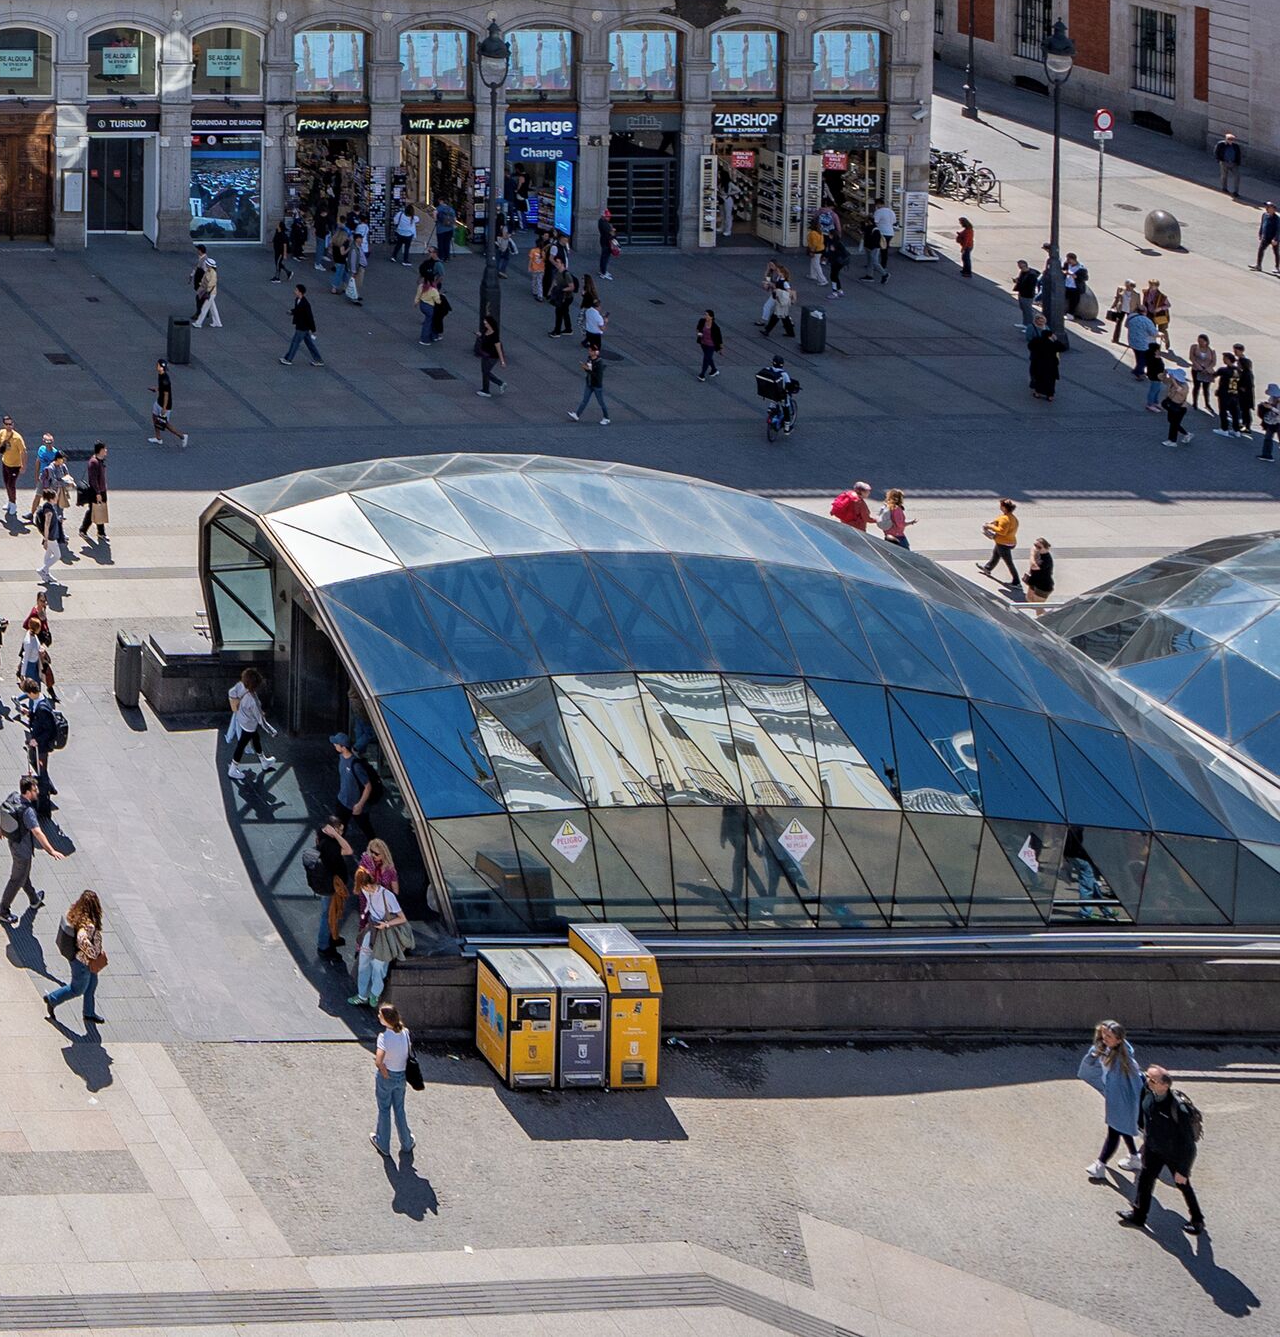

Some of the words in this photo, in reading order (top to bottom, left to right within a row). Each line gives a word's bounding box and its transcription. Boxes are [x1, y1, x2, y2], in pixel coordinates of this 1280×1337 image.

[109, 119, 147, 128] TURISMO
[191, 119, 228, 127] COMUNIDAD
[228, 119, 238, 127] DE
[238, 119, 263, 127] MADRID
[409, 119, 434, 129] WITH
[714, 113, 778, 127] ZAPSHOP
[816, 113, 881, 127] ZAPSHOP
[297, 119, 325, 132] FROM
[326, 119, 369, 130] MADRID
[508, 117, 573, 136] Change
[520, 147, 564, 160] Change
[733, 159, 752, 168] -50%
[825, 161, 845, 170] -50%
[556, 836, 583, 845] PELIGRO
